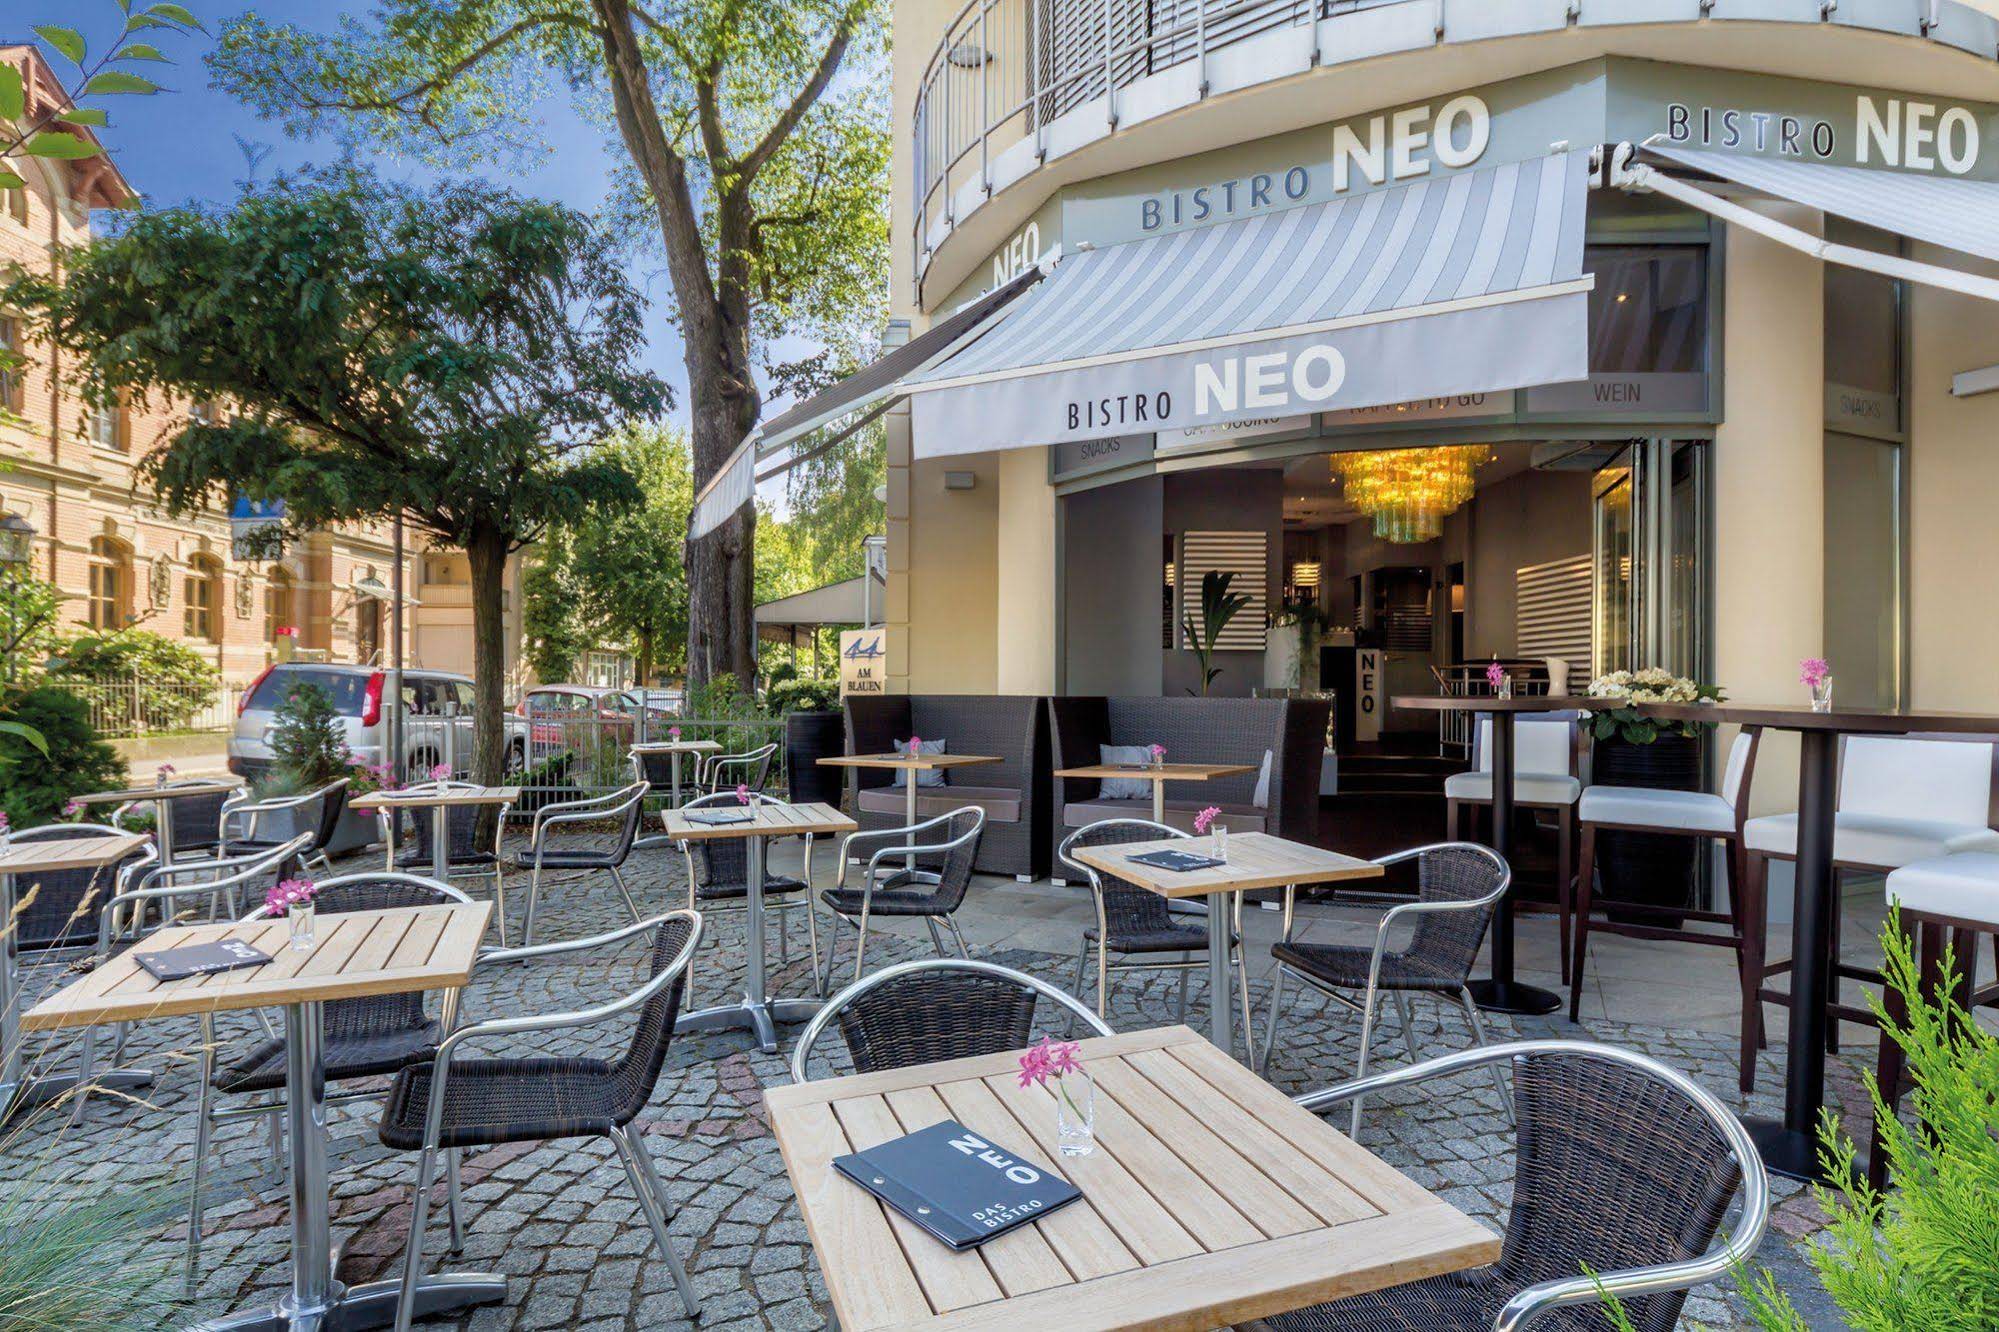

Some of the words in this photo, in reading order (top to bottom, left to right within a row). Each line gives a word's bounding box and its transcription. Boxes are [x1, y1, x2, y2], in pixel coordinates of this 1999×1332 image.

[1667, 103, 1835, 158] BISTRO
[1855, 95, 1980, 175] NEO
[1141, 166, 1310, 231] BISTRO
[1332, 95, 1491, 193] NEO
[993, 221, 1040, 288] NEO
[1068, 391, 1172, 430] BISTRO
[1194, 344, 1346, 416] NEO
[1594, 382, 1641, 402] WEIN
[1081, 436, 1121, 460] SNACKS
[847, 681, 881, 692] BLAUEN
[857, 668, 872, 678] AM
[1361, 653, 1375, 713] NEO
[948, 1134, 1040, 1184] NEO
[972, 1202, 1007, 1221] DAS
[983, 1200, 1043, 1228] BISTRO
